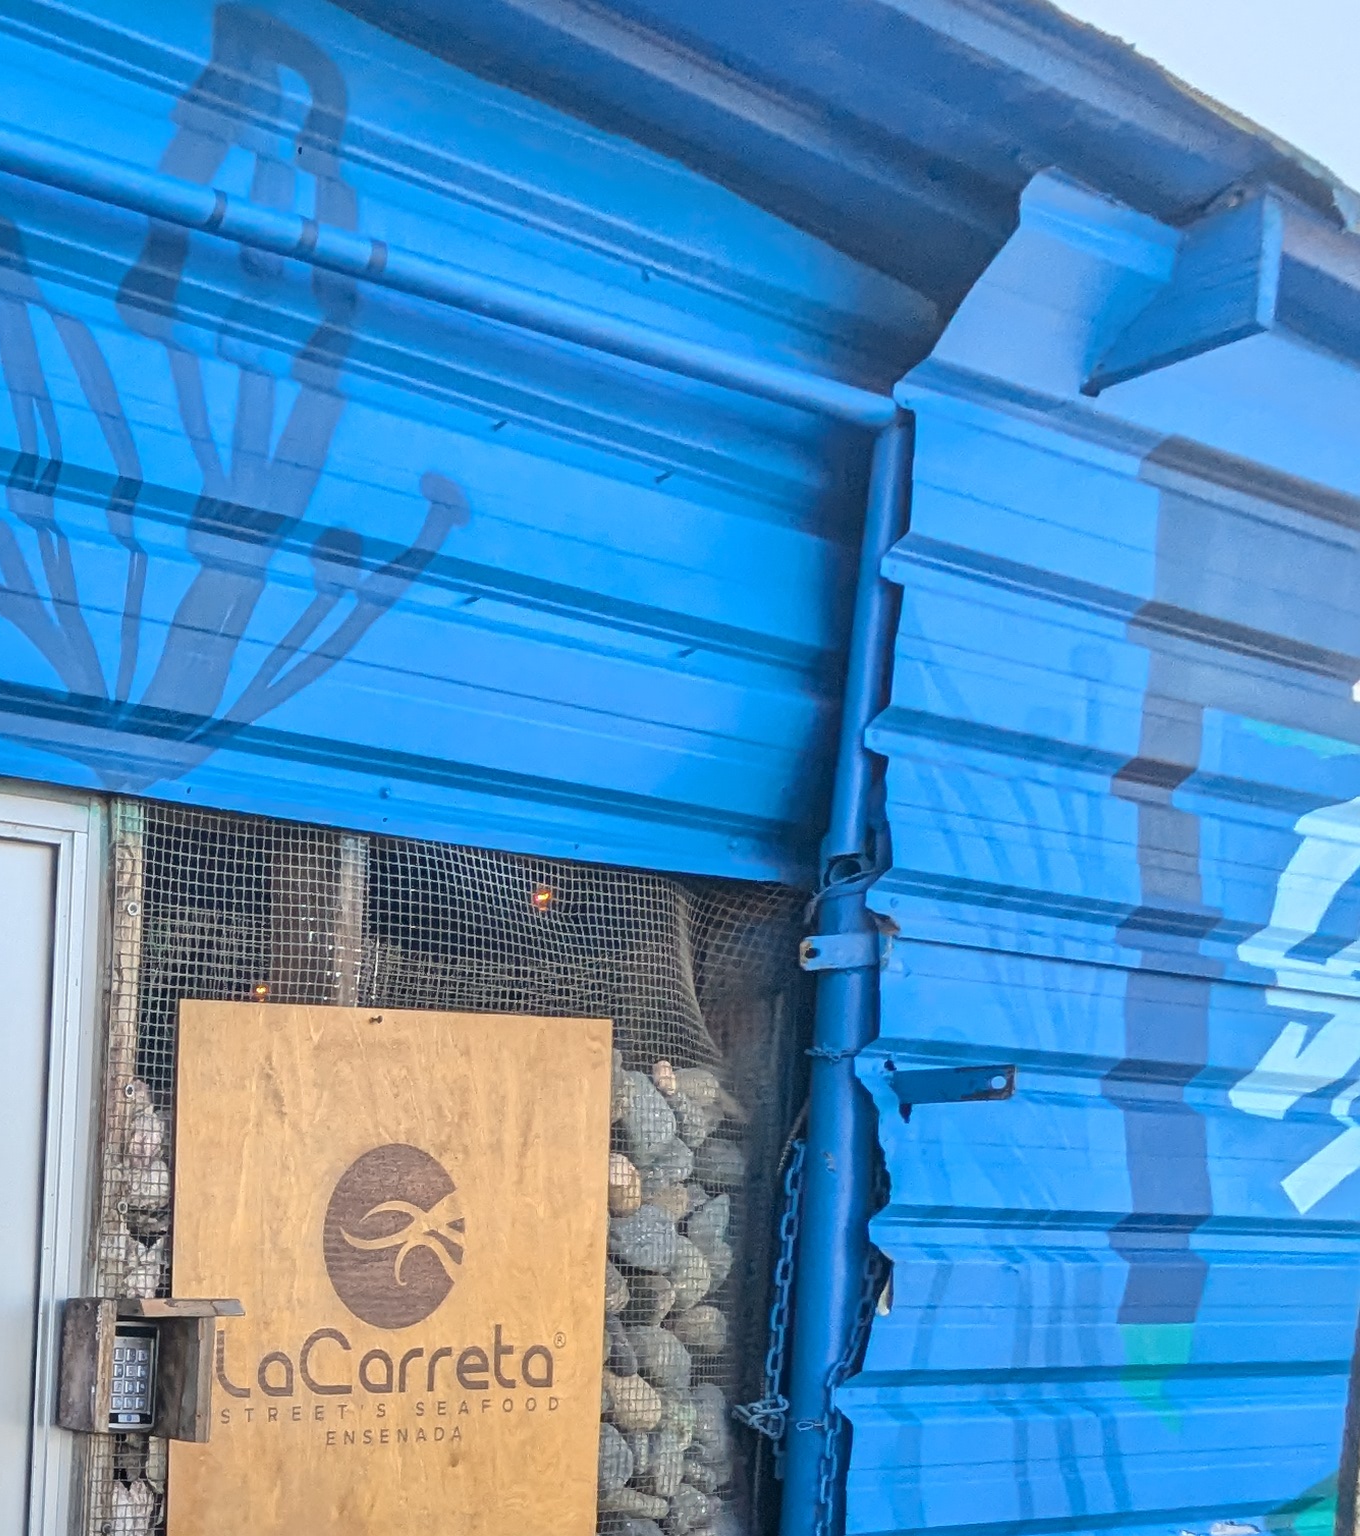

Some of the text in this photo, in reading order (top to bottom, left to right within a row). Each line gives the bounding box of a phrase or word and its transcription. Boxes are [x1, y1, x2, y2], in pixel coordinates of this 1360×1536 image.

[220, 1396, 560, 1425] STREET'S SEAFOOD
[326, 1426, 463, 1447] ENSENADA
